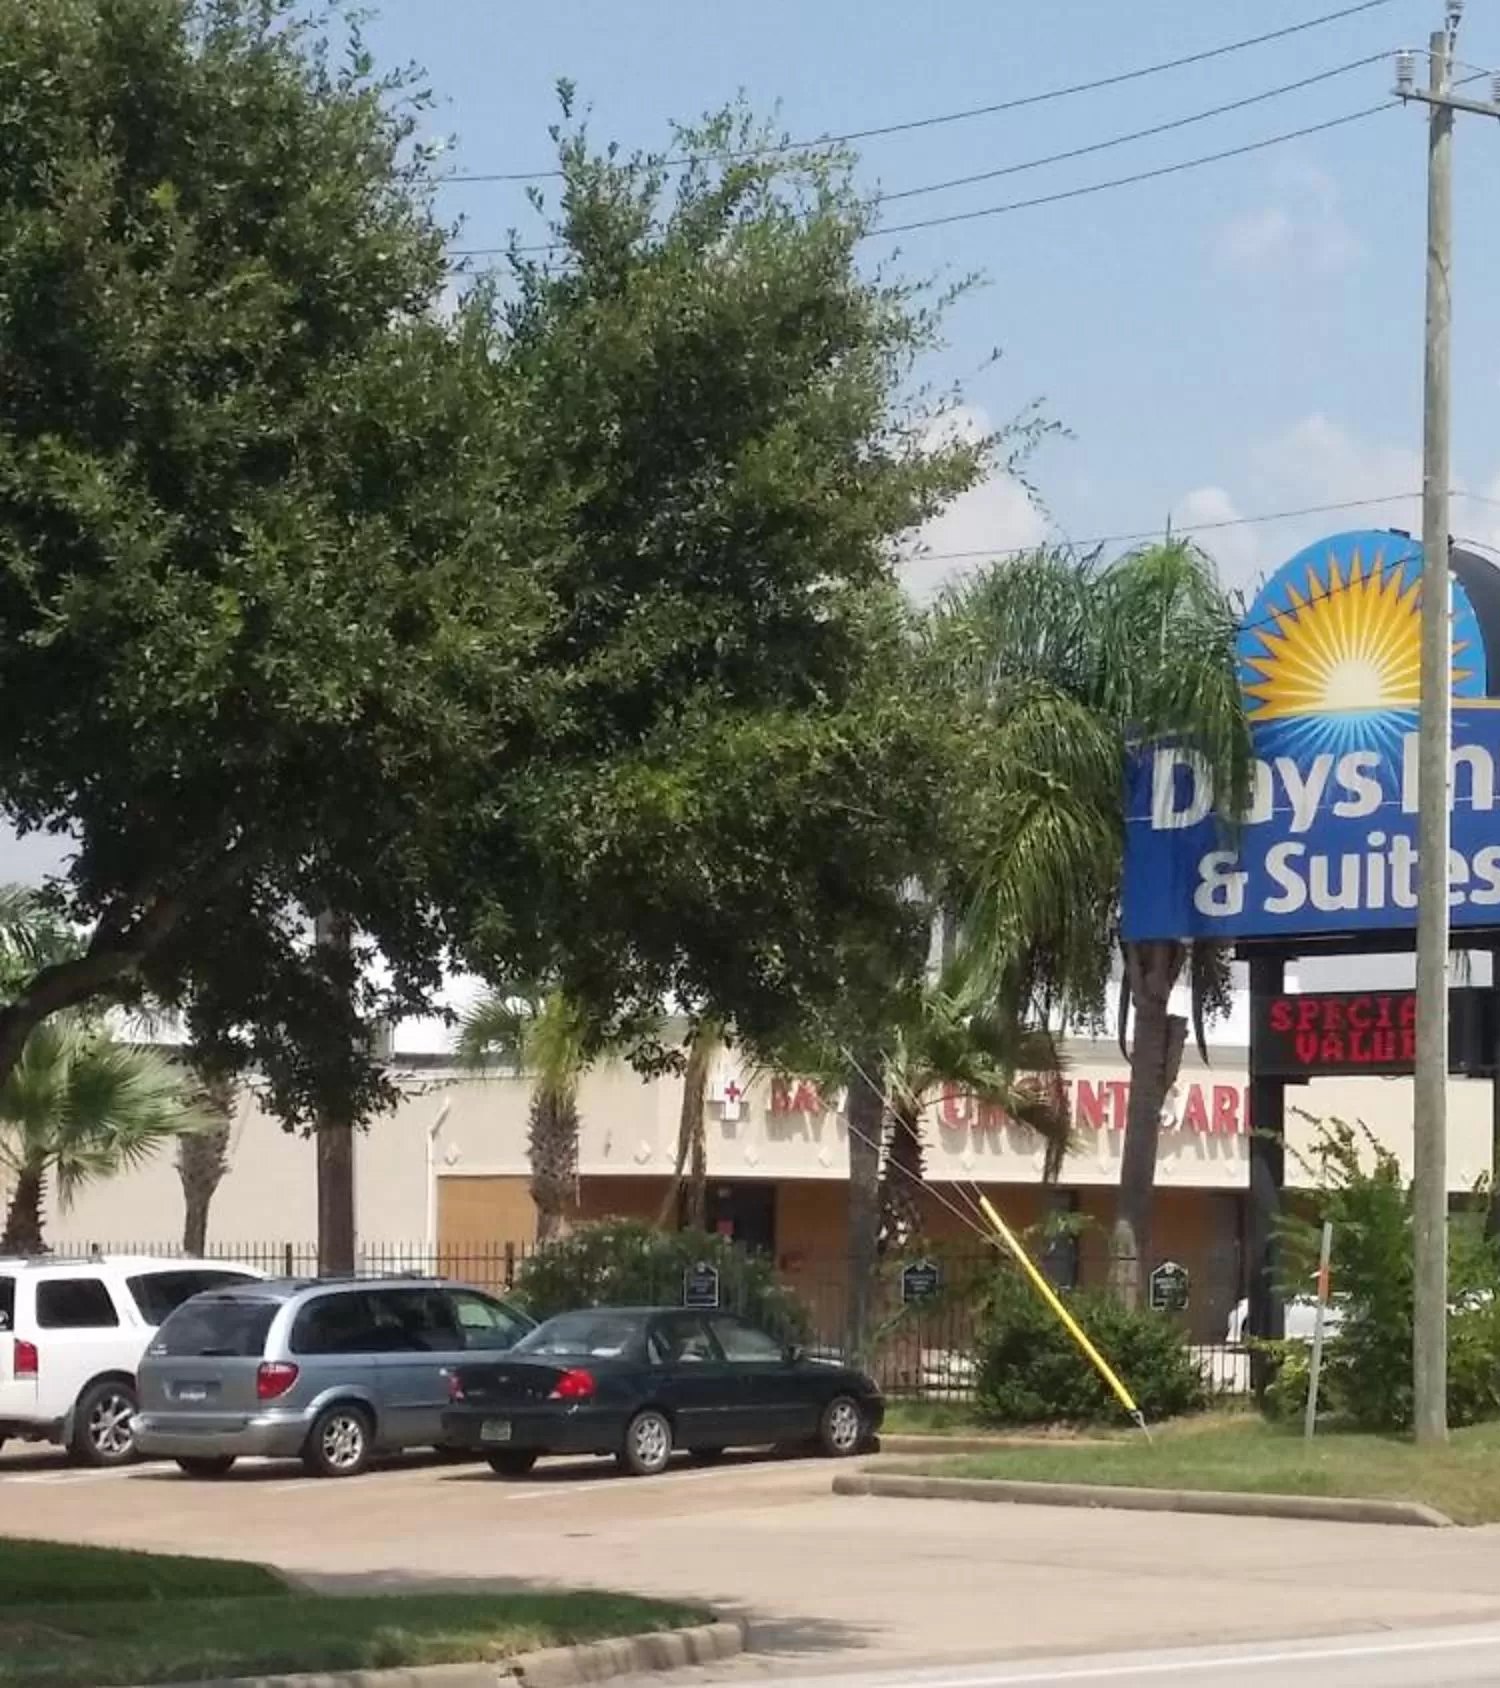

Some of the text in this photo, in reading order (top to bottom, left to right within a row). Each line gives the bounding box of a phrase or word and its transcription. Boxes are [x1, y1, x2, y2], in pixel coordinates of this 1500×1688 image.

[1151, 746, 1383, 833] Days
[1194, 850, 1249, 917] &
[1270, 994, 1417, 1032] SPECIA
